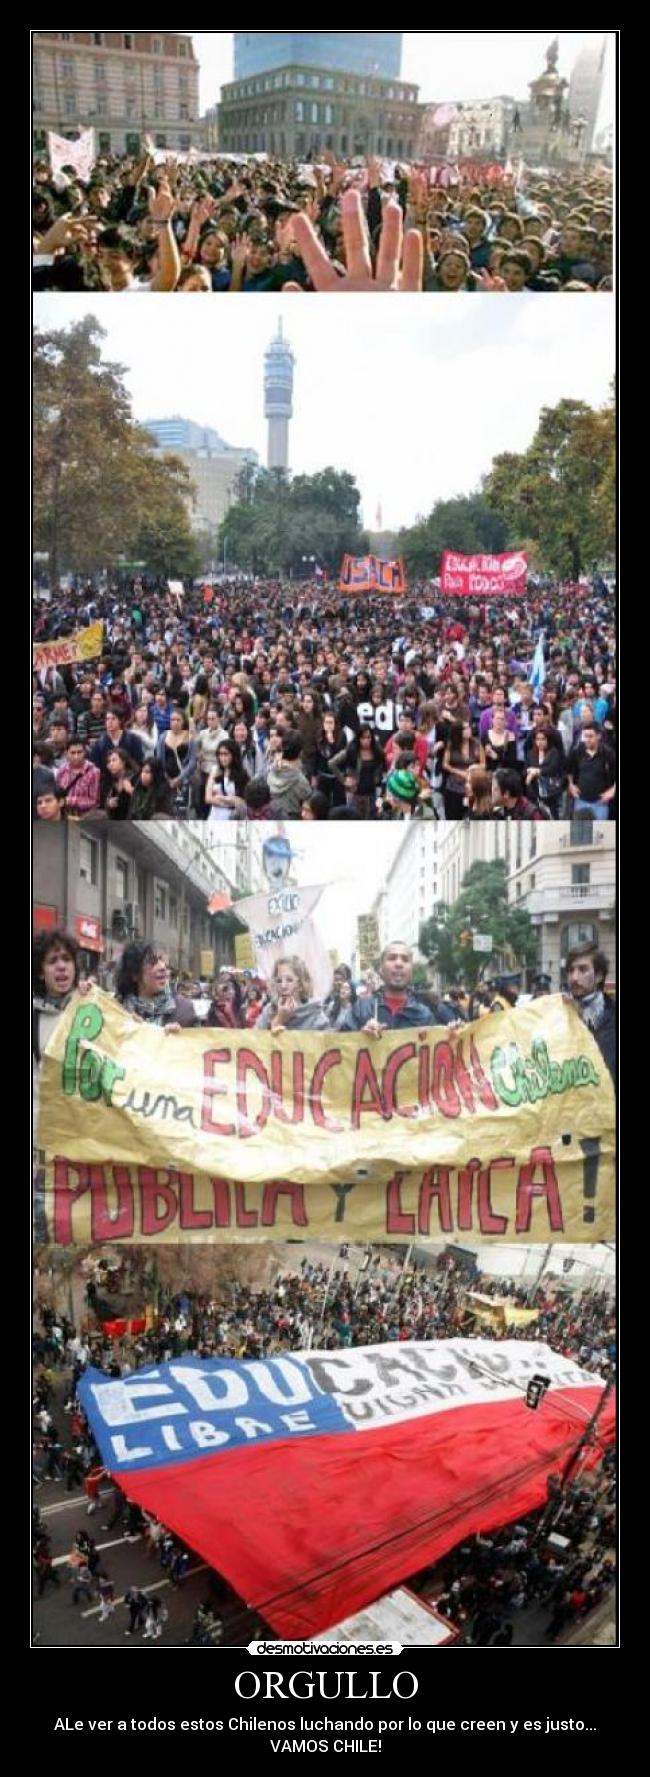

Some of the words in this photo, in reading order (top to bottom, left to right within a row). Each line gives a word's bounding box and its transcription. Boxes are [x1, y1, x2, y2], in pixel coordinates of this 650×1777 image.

[62, 1003, 126, 1107] Por
[123, 1089, 200, 1130] una
[110, 1410, 318, 1463] LIBRE
